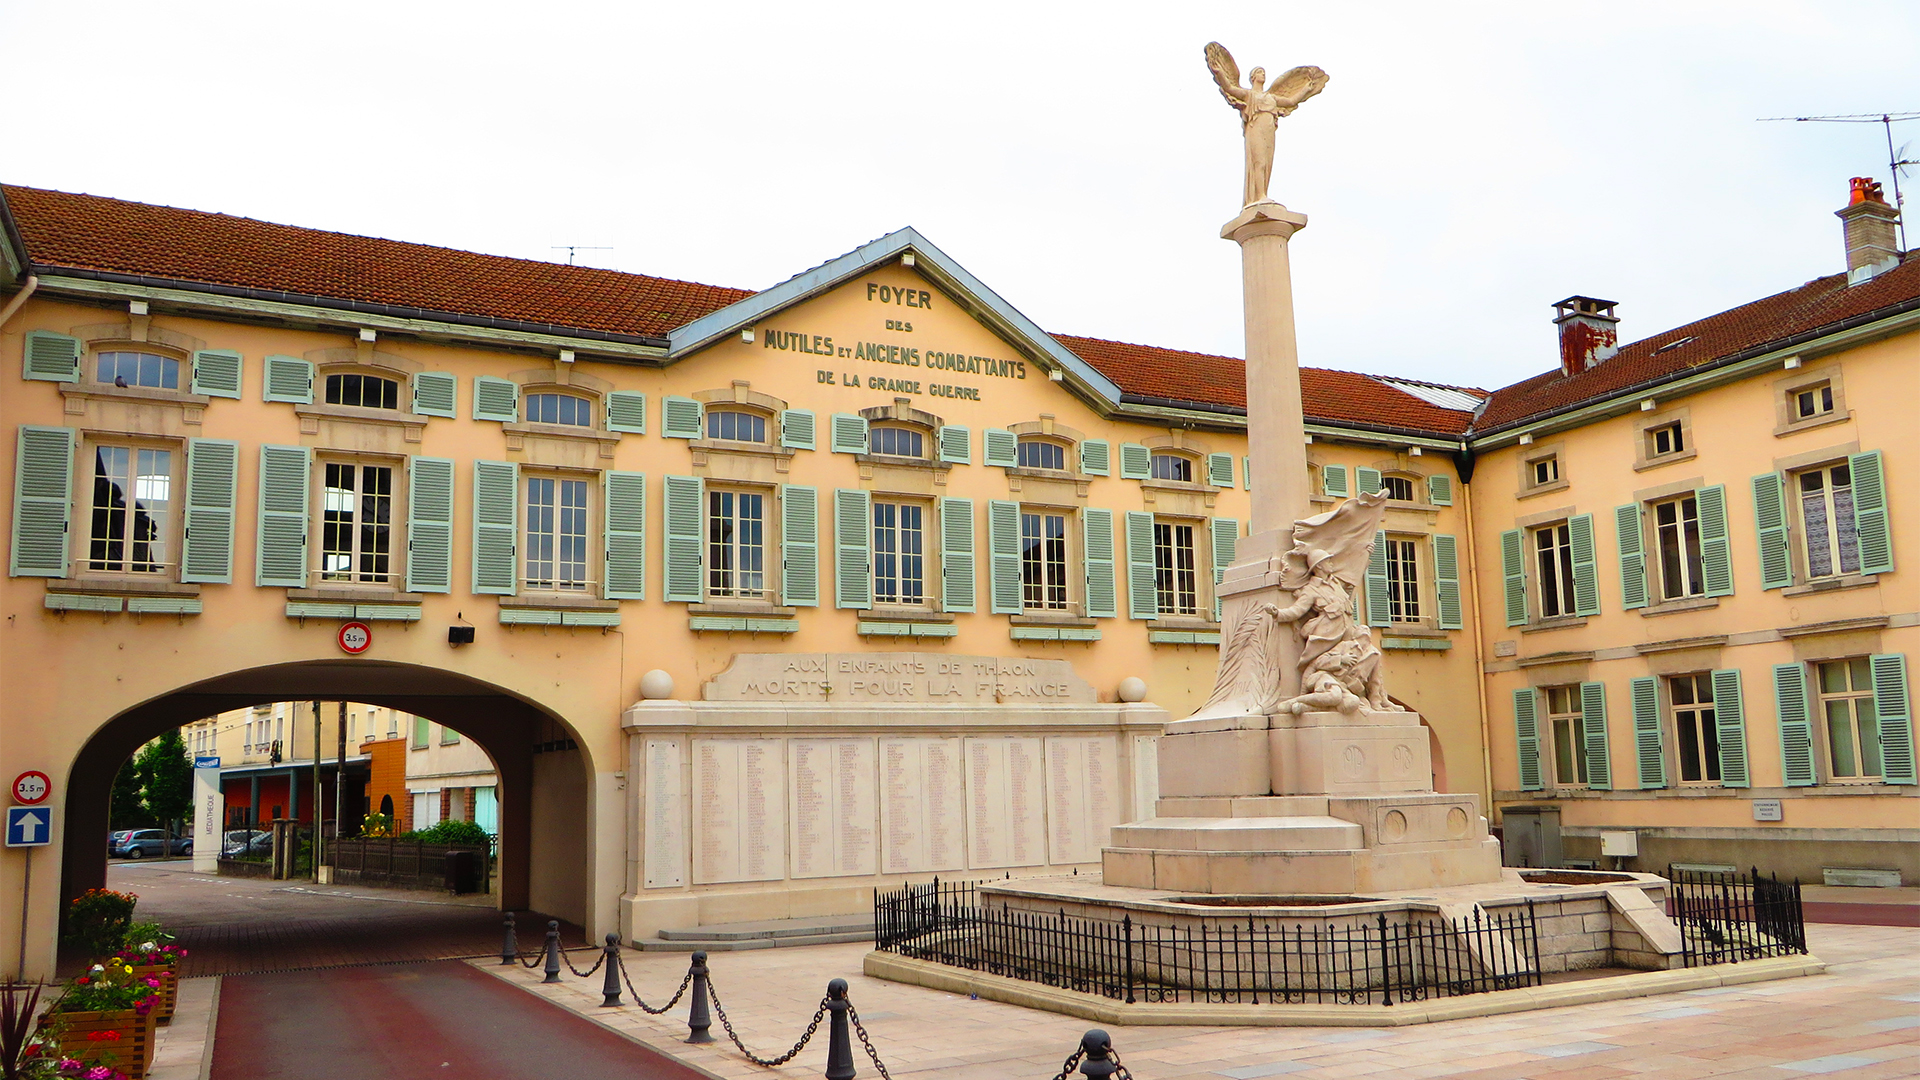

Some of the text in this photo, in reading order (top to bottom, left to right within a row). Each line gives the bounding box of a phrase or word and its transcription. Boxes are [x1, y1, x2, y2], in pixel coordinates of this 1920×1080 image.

[867, 282, 932, 310] FOYER
[885, 319, 913, 332] DES
[764, 329, 1026, 380] MUTILES ET ANCIENS COMBATTANTS
[817, 369, 981, 401] DE LA GRANDE GUERRE
[783, 659, 1035, 677] AUX ENFANTS DE THAON
[740, 680, 1071, 698] MORTS POUR LA FRANCE
